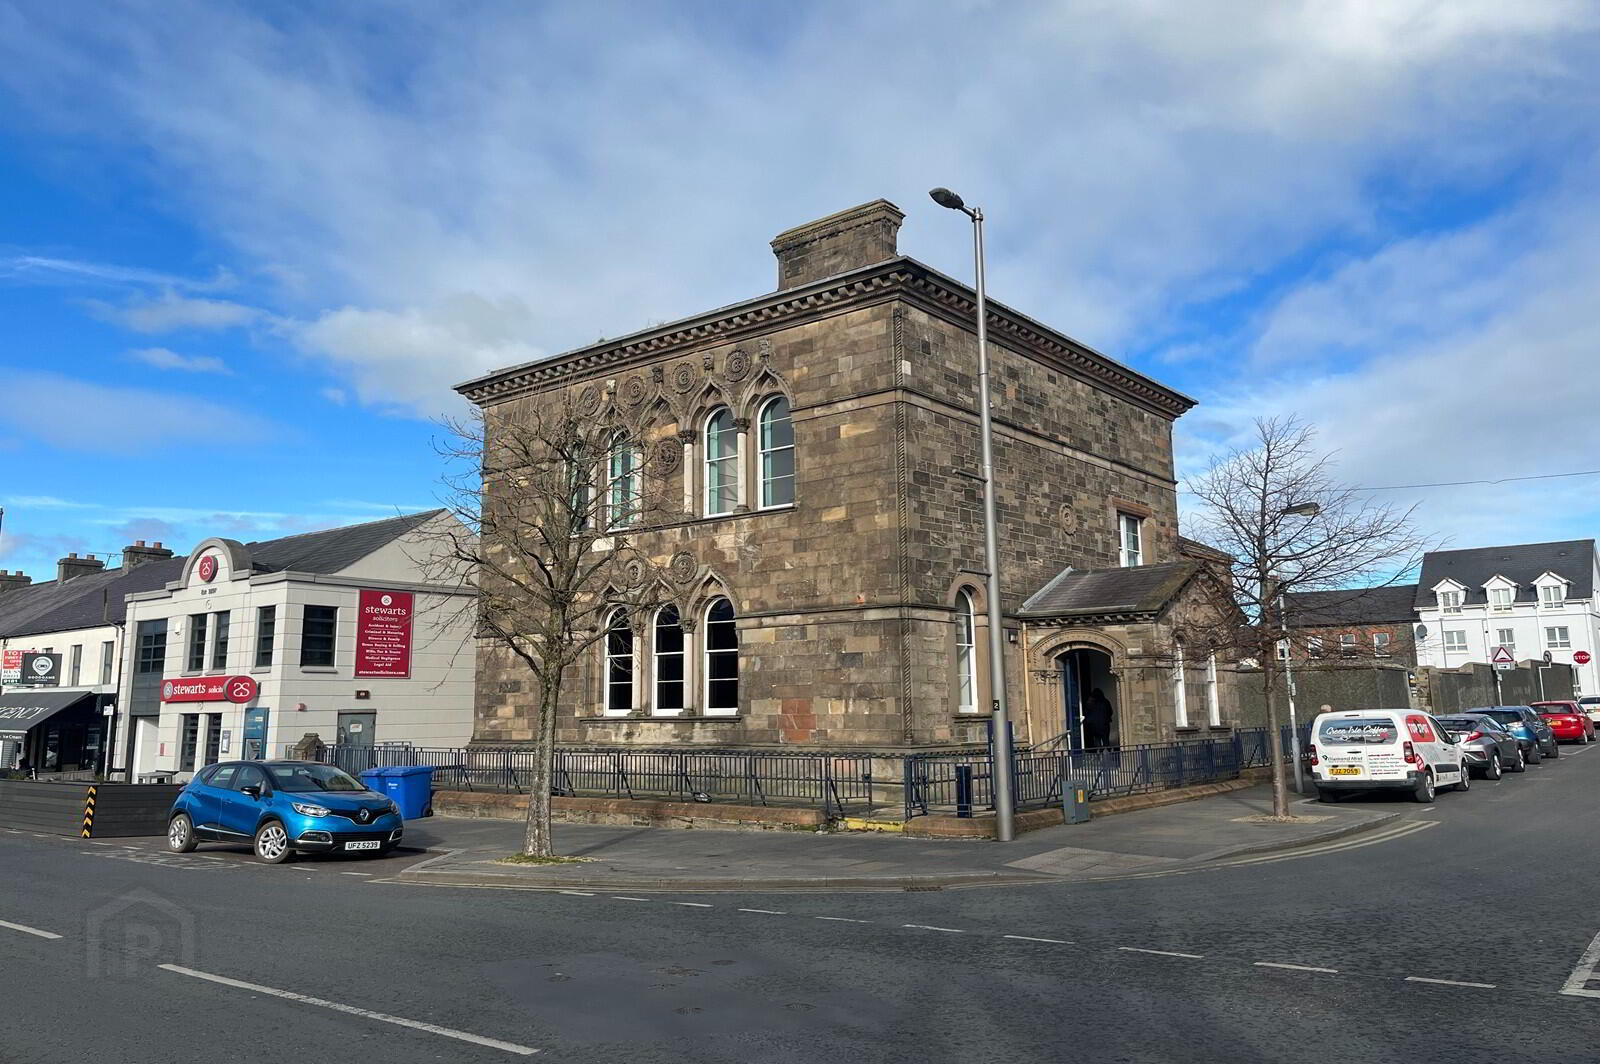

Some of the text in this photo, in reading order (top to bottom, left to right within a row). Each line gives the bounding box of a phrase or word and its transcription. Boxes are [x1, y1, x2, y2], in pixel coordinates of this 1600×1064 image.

[365, 606, 406, 616] stewarts
[173, 683, 206, 695] stewarts
[1326, 725, 1388, 735] Green Isle Coffee
